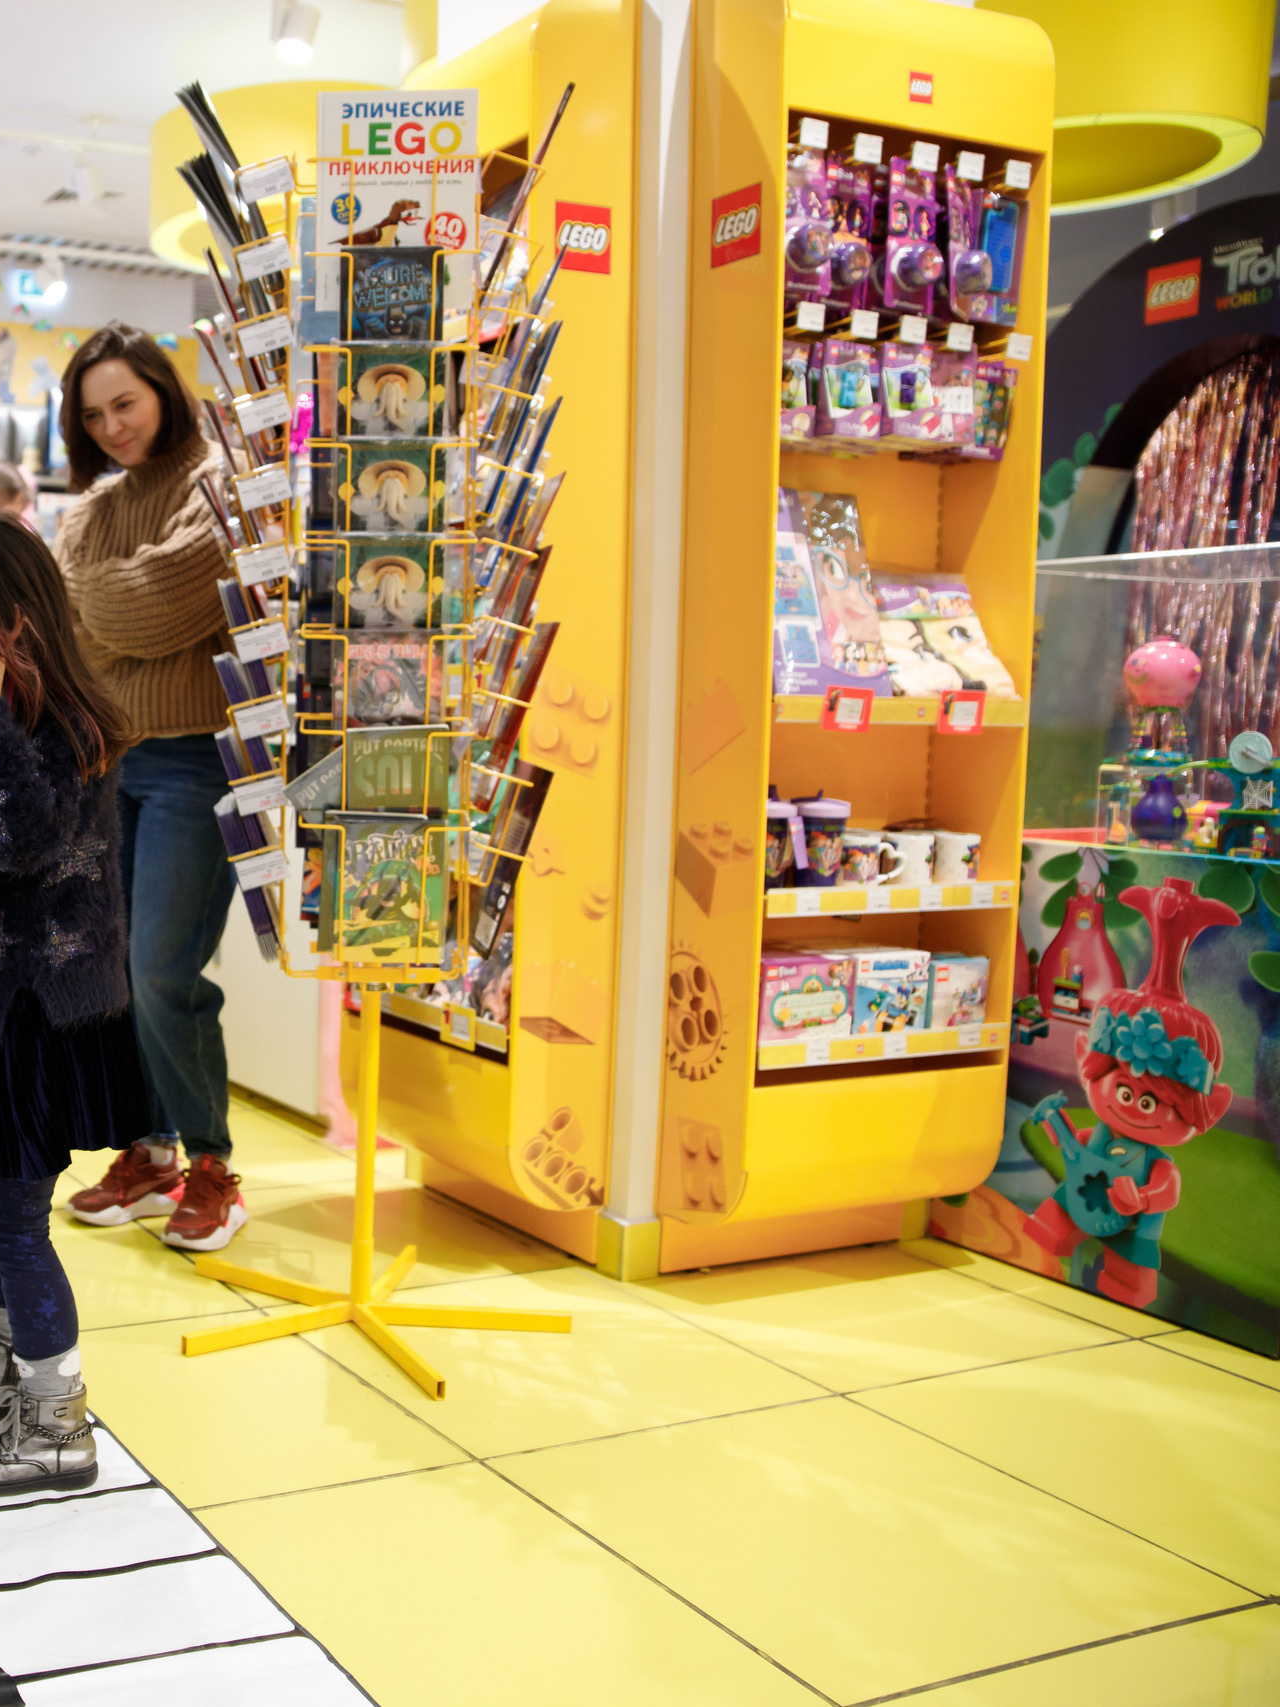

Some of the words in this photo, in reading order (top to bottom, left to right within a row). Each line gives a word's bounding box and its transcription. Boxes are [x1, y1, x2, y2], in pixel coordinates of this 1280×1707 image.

[341, 100, 465, 119] ЭПИЧЕСКИЕ
[341, 121, 462, 156] LEGO
[328, 159, 475, 176] ПРИКЛЮЧЕНИЯ
[434, 215, 463, 238] 40
[560, 222, 607, 252] LEGO
[715, 206, 757, 244] LEGO
[1150, 276, 1196, 306] LEGO
[353, 738, 381, 755] PUT
